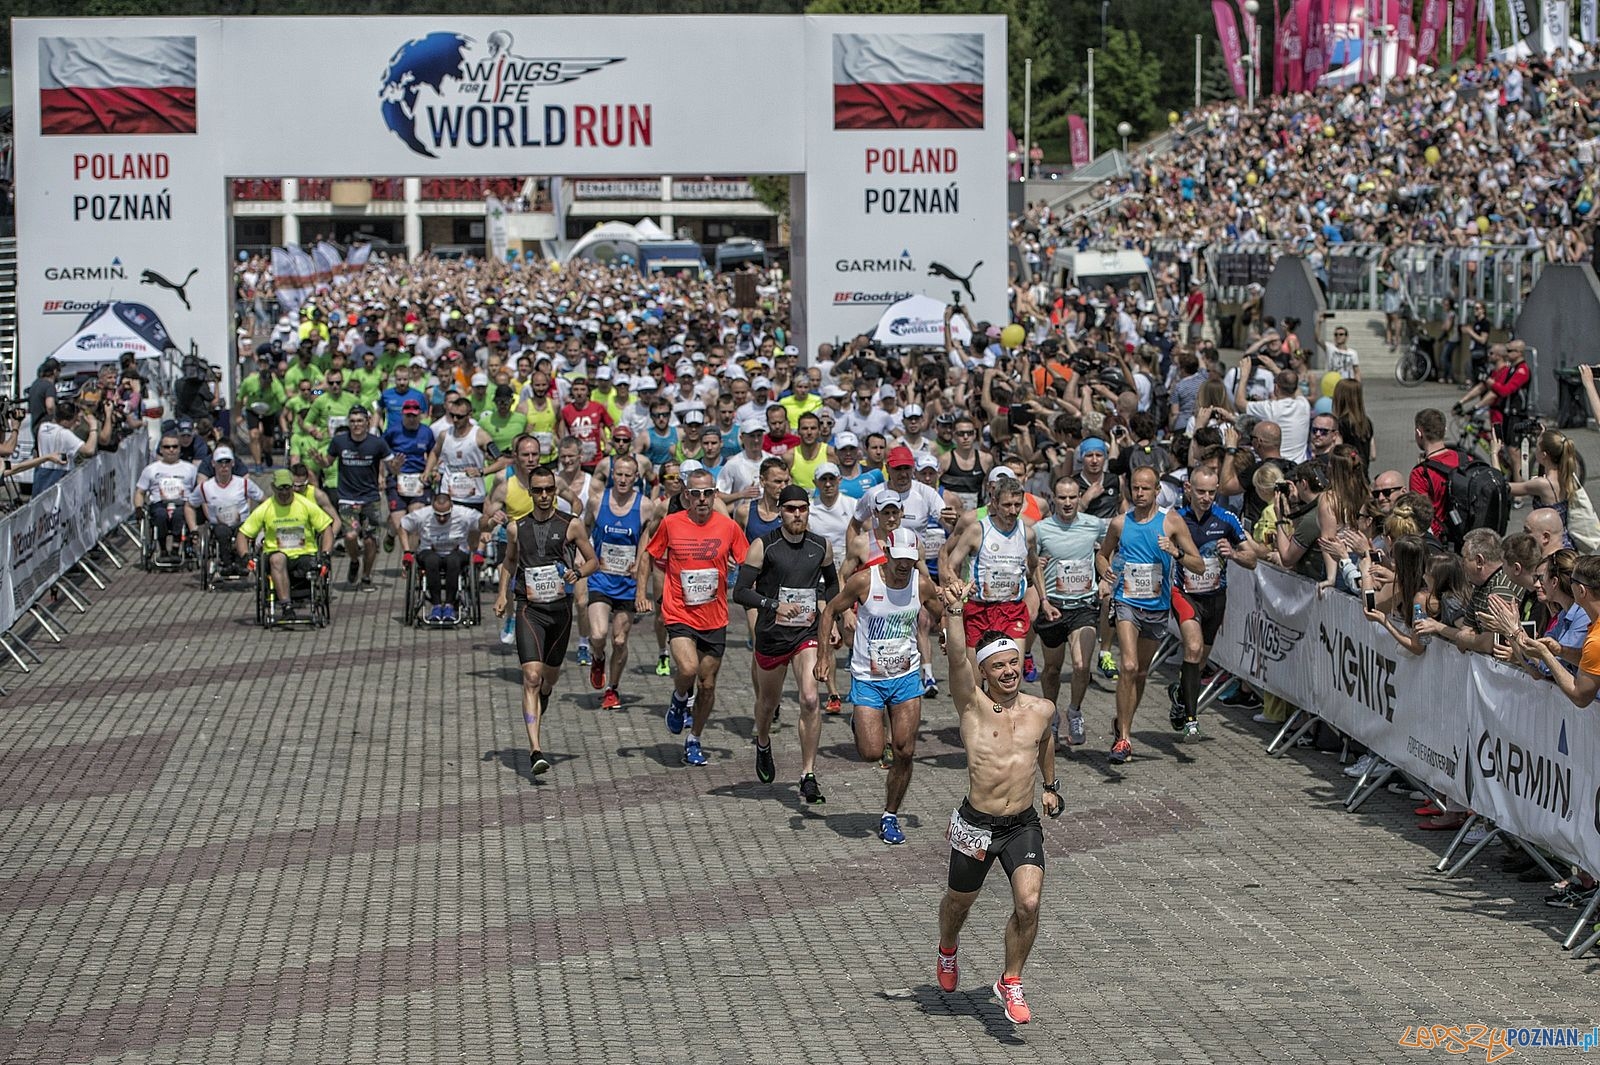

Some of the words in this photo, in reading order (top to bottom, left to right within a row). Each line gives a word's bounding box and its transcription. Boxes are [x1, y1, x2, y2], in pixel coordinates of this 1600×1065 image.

[465, 62, 561, 82] WINGS
[458, 84, 480, 93] FOR
[477, 83, 534, 103] LIFE
[427, 104, 567, 149] WORLD
[573, 103, 653, 148] RUN
[73, 153, 170, 181] POLAND
[865, 148, 958, 174] POLAND
[73, 187, 172, 221] POZNAŃ
[865, 182, 960, 214] POZNAŃ
[45, 267, 124, 281] GARMIN
[835, 258, 911, 273] GARMIN
[535, 581, 556, 591] 8670
[687, 584, 712, 592] 74664
[1061, 575, 1090, 583] 110605
[877, 656, 905, 665] 55065
[1477, 729, 1571, 819] GARMIN
